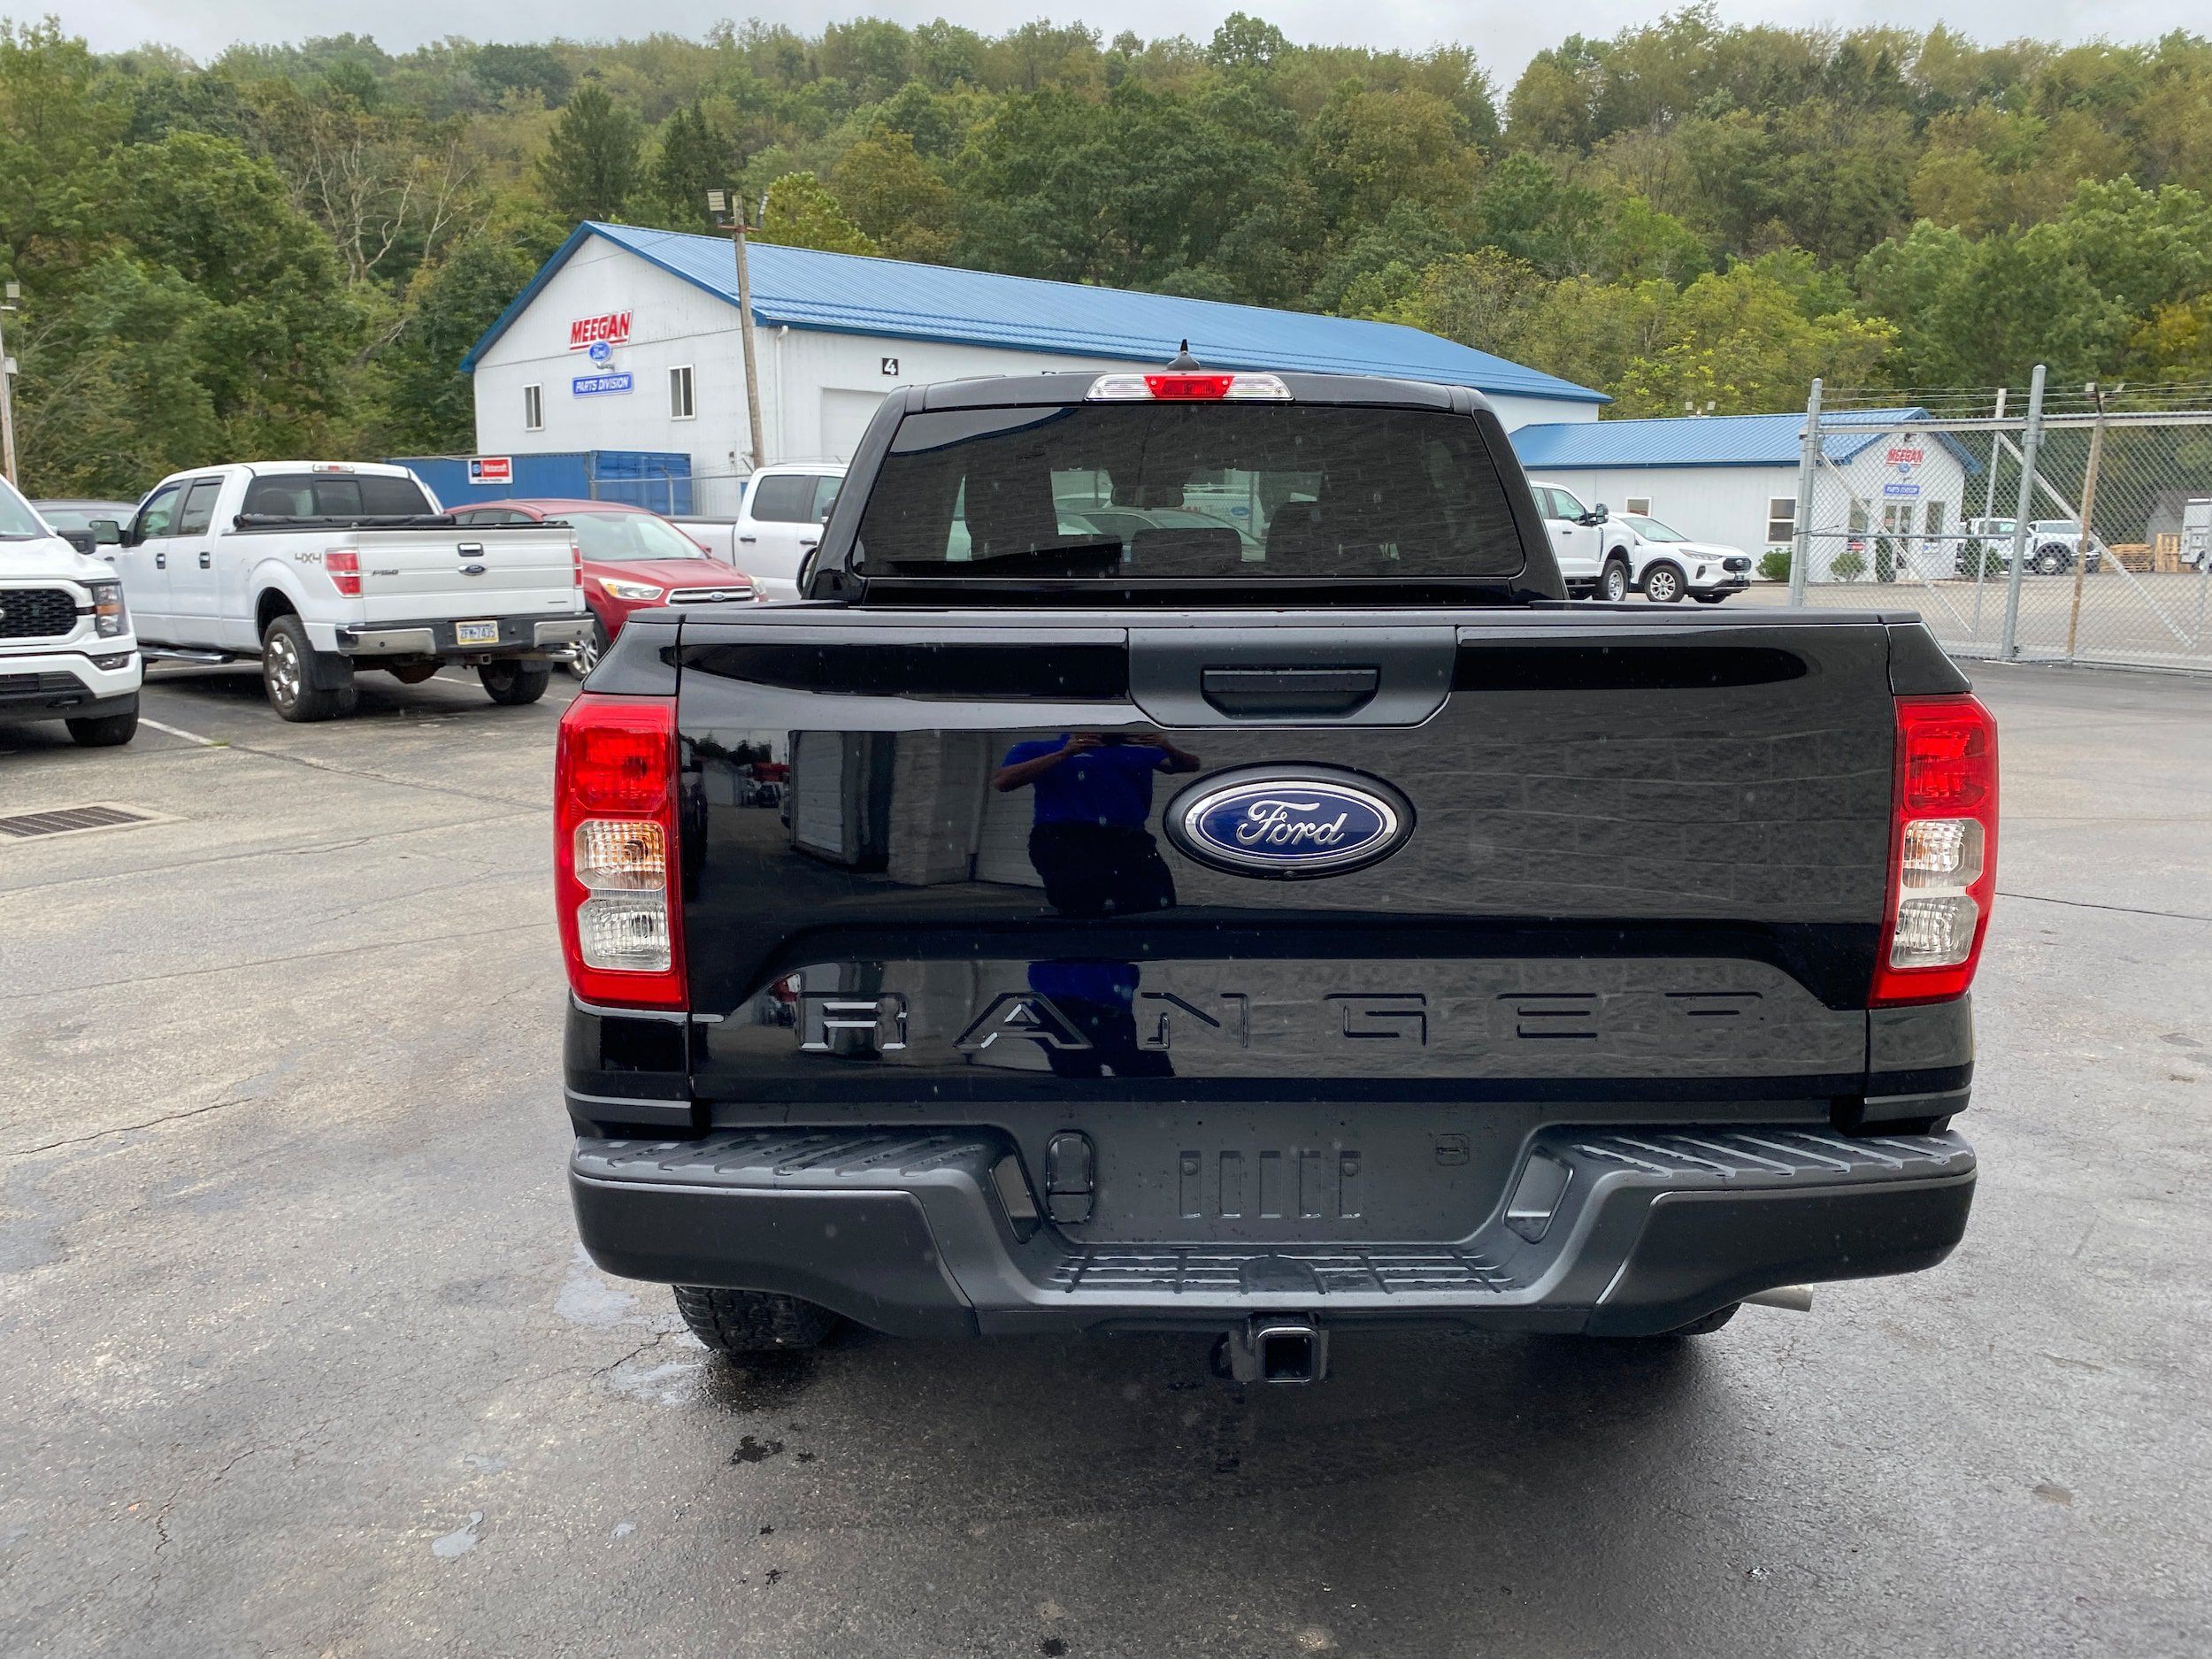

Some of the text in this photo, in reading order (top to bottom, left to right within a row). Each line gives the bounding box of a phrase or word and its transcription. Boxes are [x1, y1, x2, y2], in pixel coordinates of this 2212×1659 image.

[570, 311, 631, 344] MEEGAN
[884, 358, 896, 375] 4
[575, 376, 630, 393] PARTS DIVISION
[1236, 799, 1348, 846] Ford
[797, 990, 1764, 1051] RANGER
